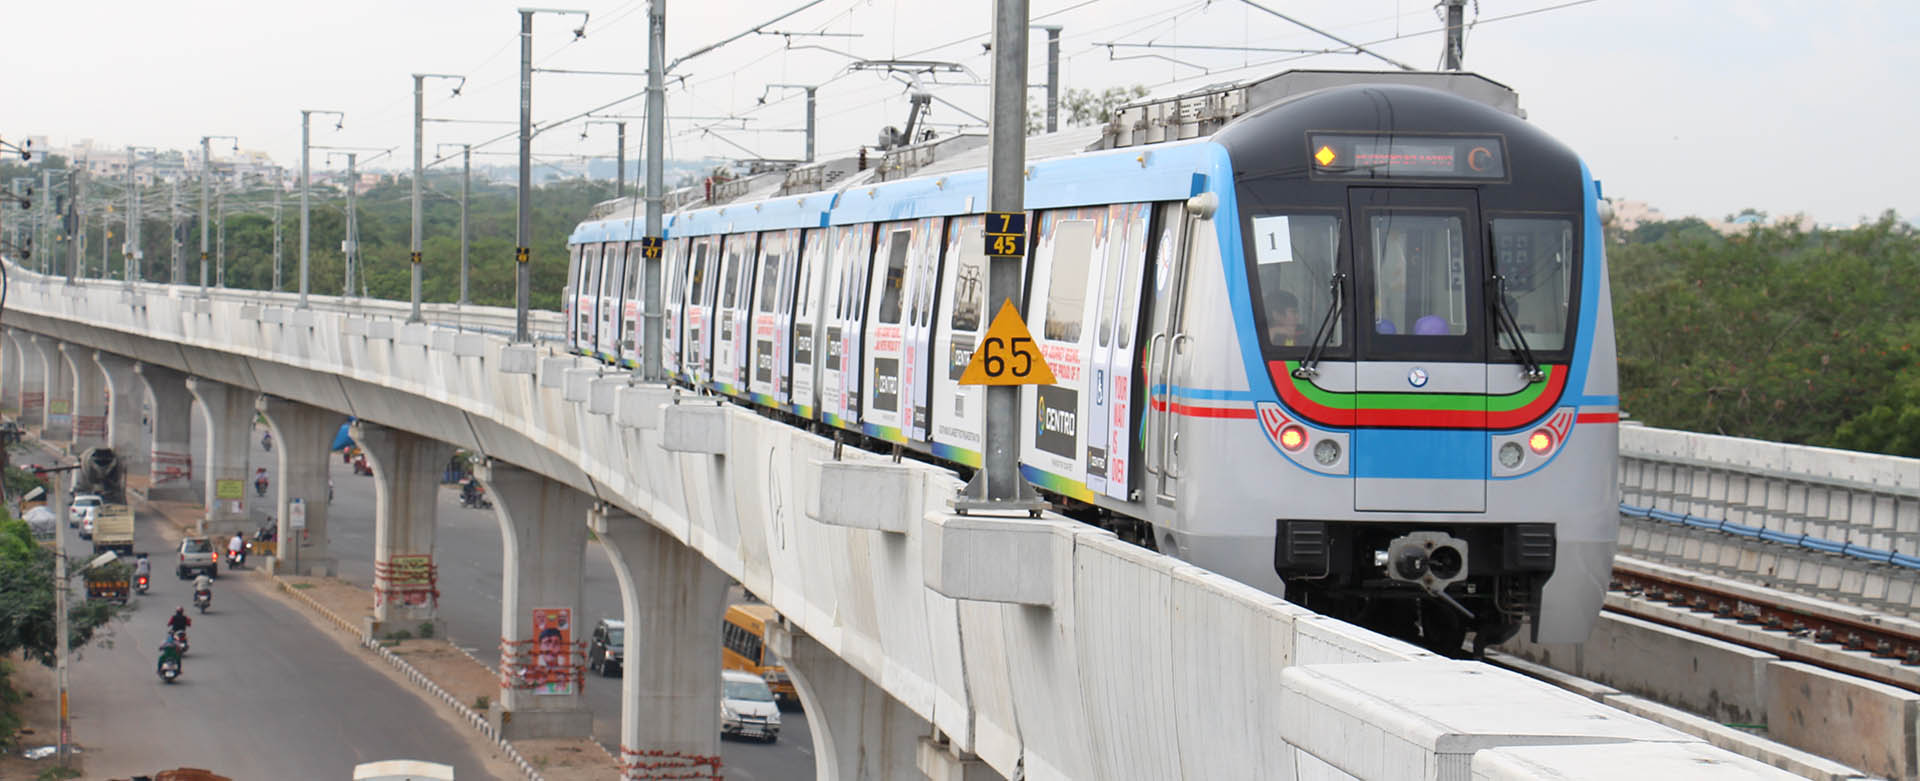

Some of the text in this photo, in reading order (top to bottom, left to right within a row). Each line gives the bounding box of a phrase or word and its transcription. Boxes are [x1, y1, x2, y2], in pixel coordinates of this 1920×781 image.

[1000, 215, 1011, 233] 7
[993, 236, 1016, 255] 45
[1267, 231, 1278, 251] 1
[984, 337, 1032, 377] 65
[1114, 375, 1128, 401] YOUR
[1045, 407, 1076, 437] CENTRO
[1111, 458, 1125, 484] OVER
